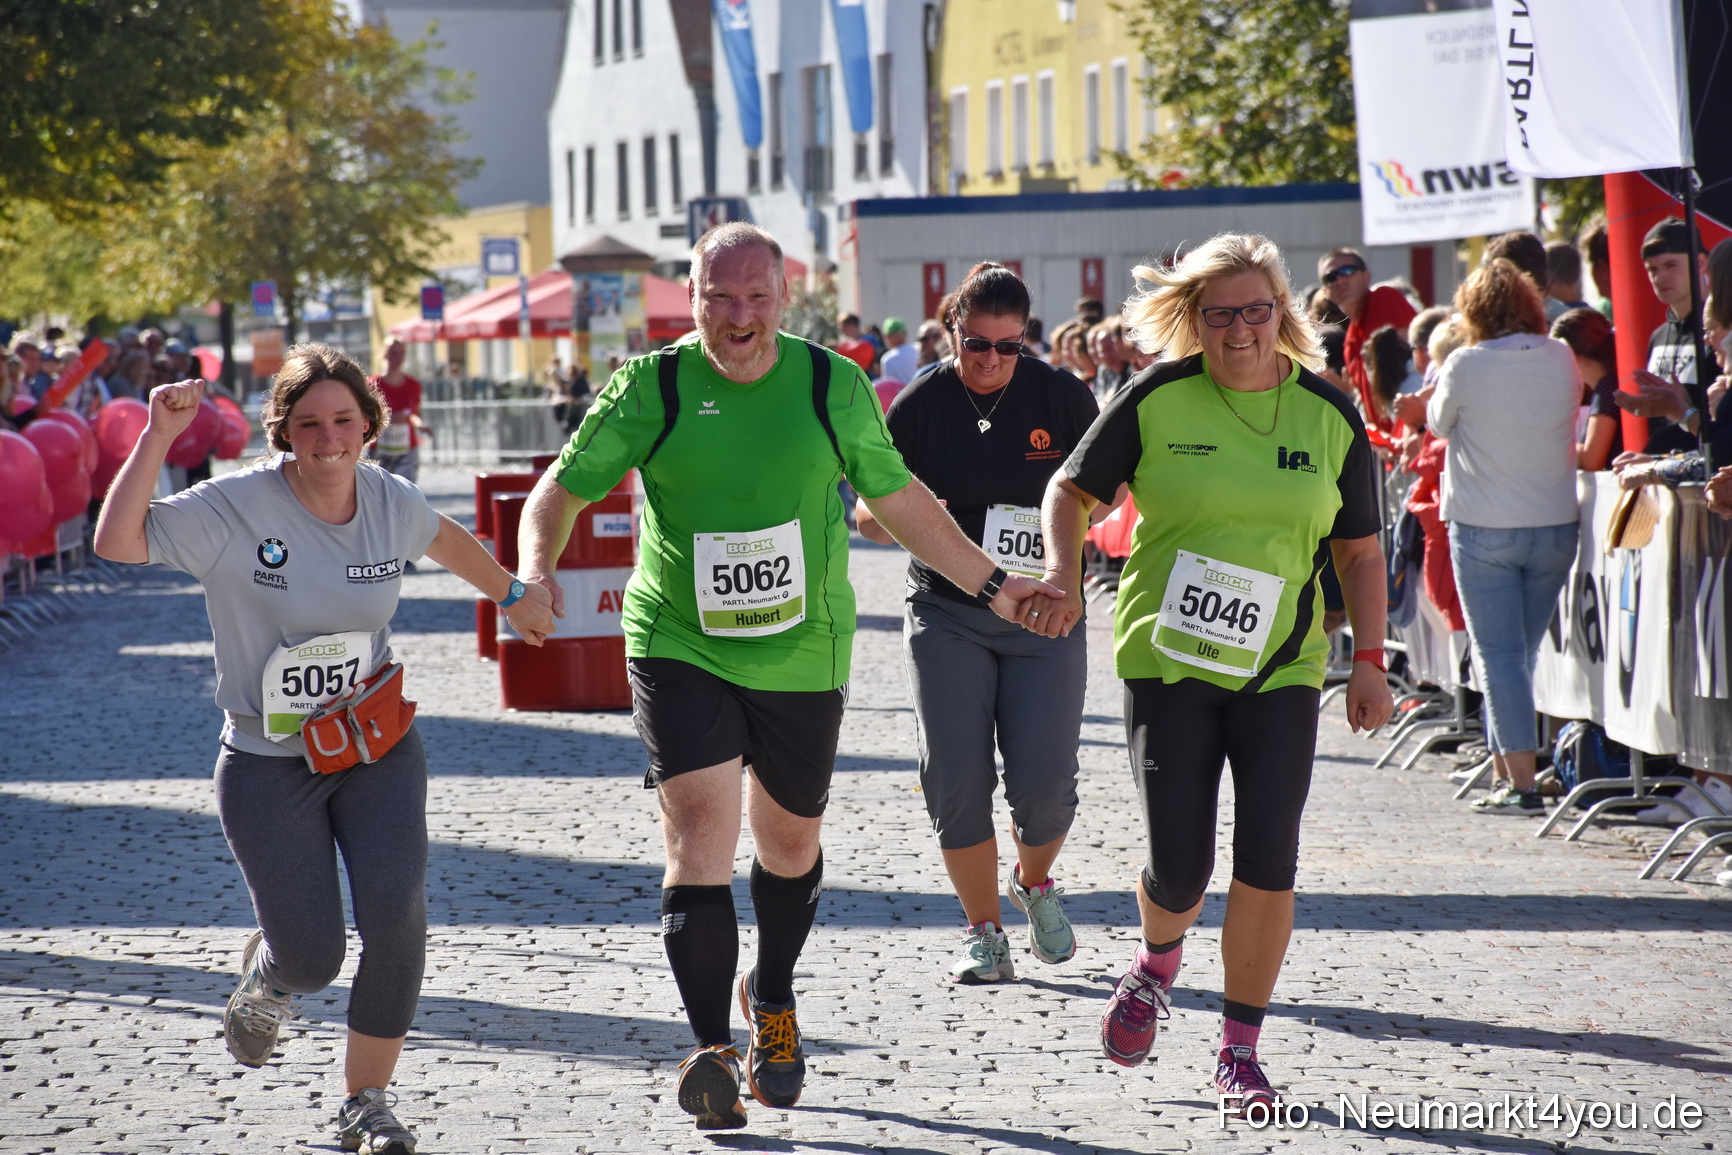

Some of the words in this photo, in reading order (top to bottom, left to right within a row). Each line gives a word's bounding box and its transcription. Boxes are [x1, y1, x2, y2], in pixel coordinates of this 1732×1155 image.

[1175, 443, 1218, 452] INTERSPORT
[1301, 465, 1317, 473] HOF
[1014, 513, 1042, 526] BOC
[726, 538, 775, 555] BOCK
[997, 528, 1046, 560] 505
[347, 558, 401, 579] BOCK
[1001, 559, 1021, 568] PARTL
[1022, 562, 1047, 571] Neumark
[254, 570, 288, 584] PARTL
[712, 555, 793, 596] 5062
[1204, 568, 1254, 592] BOCK
[254, 578, 288, 591] Neumarkt
[597, 589, 624, 614] AV
[722, 599, 747, 607] PARTL
[747, 594, 781, 605] Neumarkt
[1179, 584, 1261, 634] 5046
[735, 608, 782, 626] Hubert
[1181, 620, 1204, 634] PARTL
[1204, 629, 1237, 642] Neumarkt
[298, 641, 347, 658] BOCK
[1197, 641, 1220, 659] Ute
[282, 657, 360, 697] 5057
[290, 702, 316, 710] PARTL
